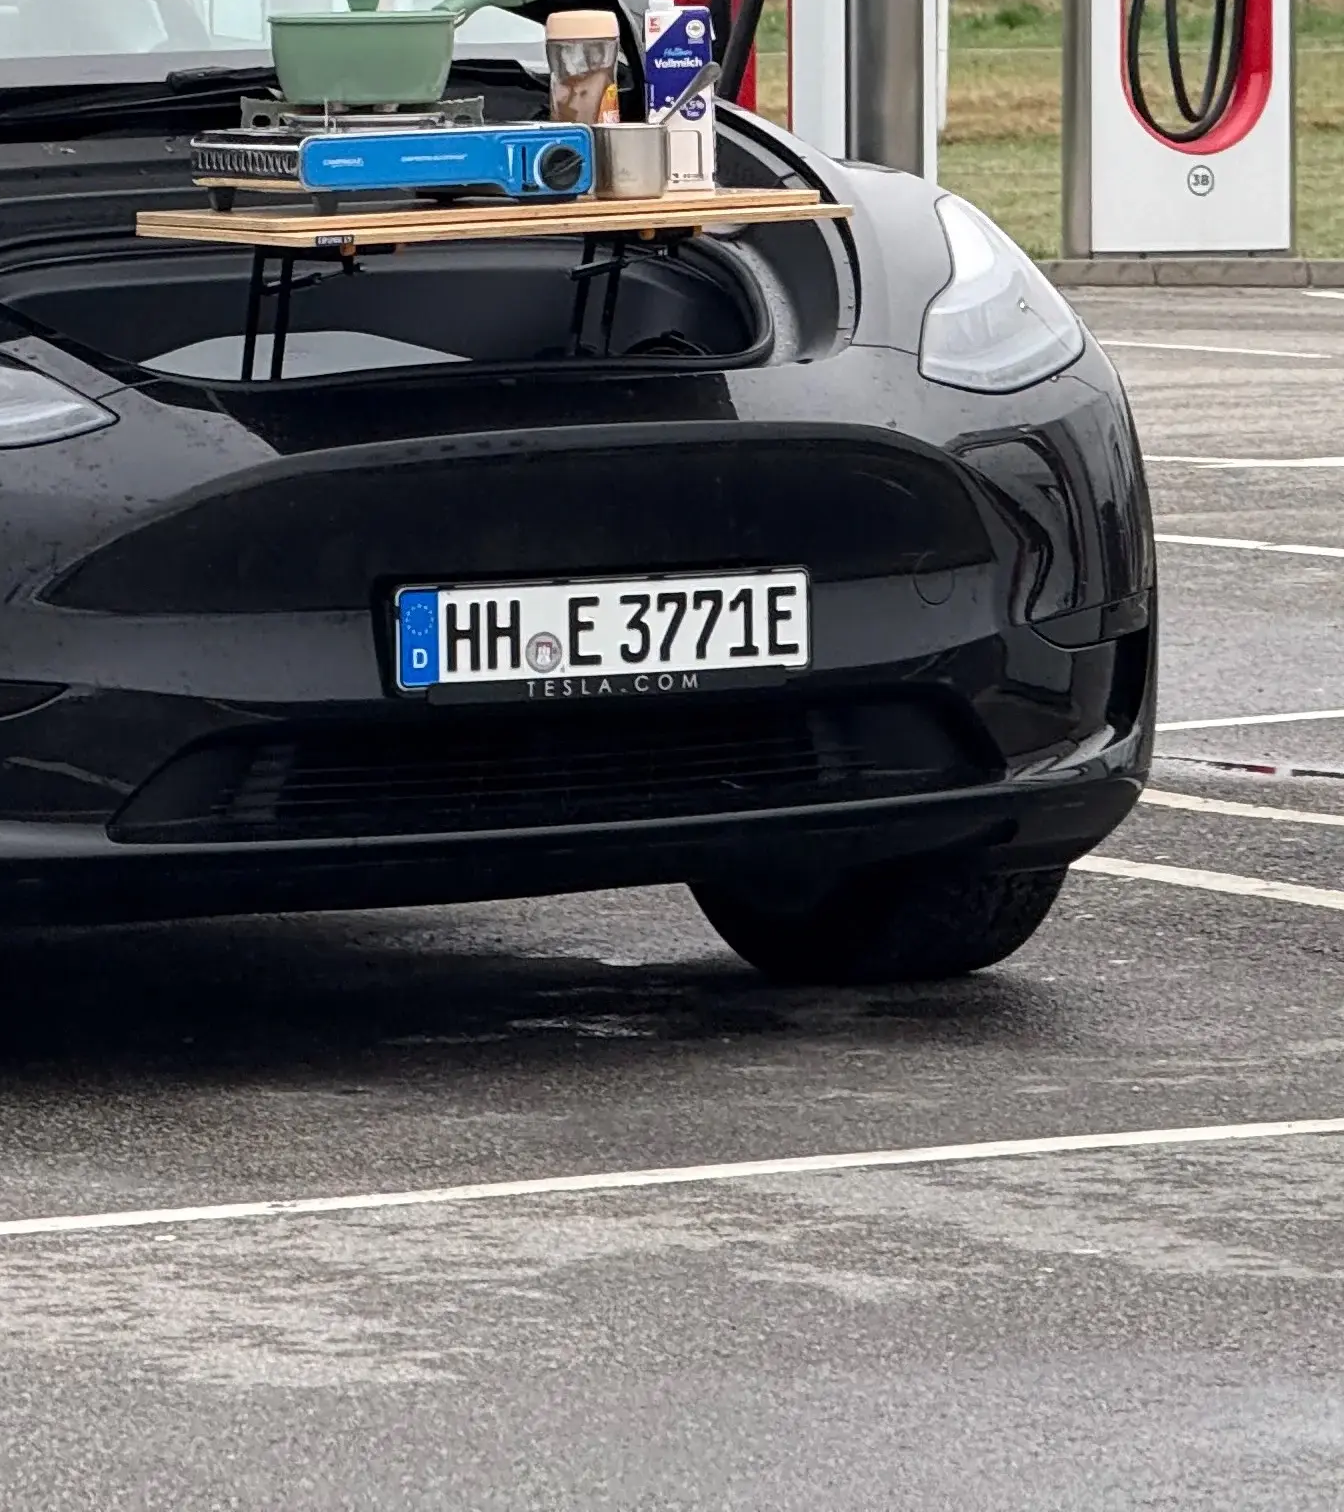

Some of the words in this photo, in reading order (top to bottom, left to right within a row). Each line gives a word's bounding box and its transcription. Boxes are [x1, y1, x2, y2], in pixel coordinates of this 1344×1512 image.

[654, 56, 703, 69] Vollmilch
[446, 599, 521, 673] HH
[568, 596, 602, 667] E
[619, 585, 800, 664] 3771E
[412, 648, 429, 669] D
[526, 673, 700, 698] TESLA.COM
